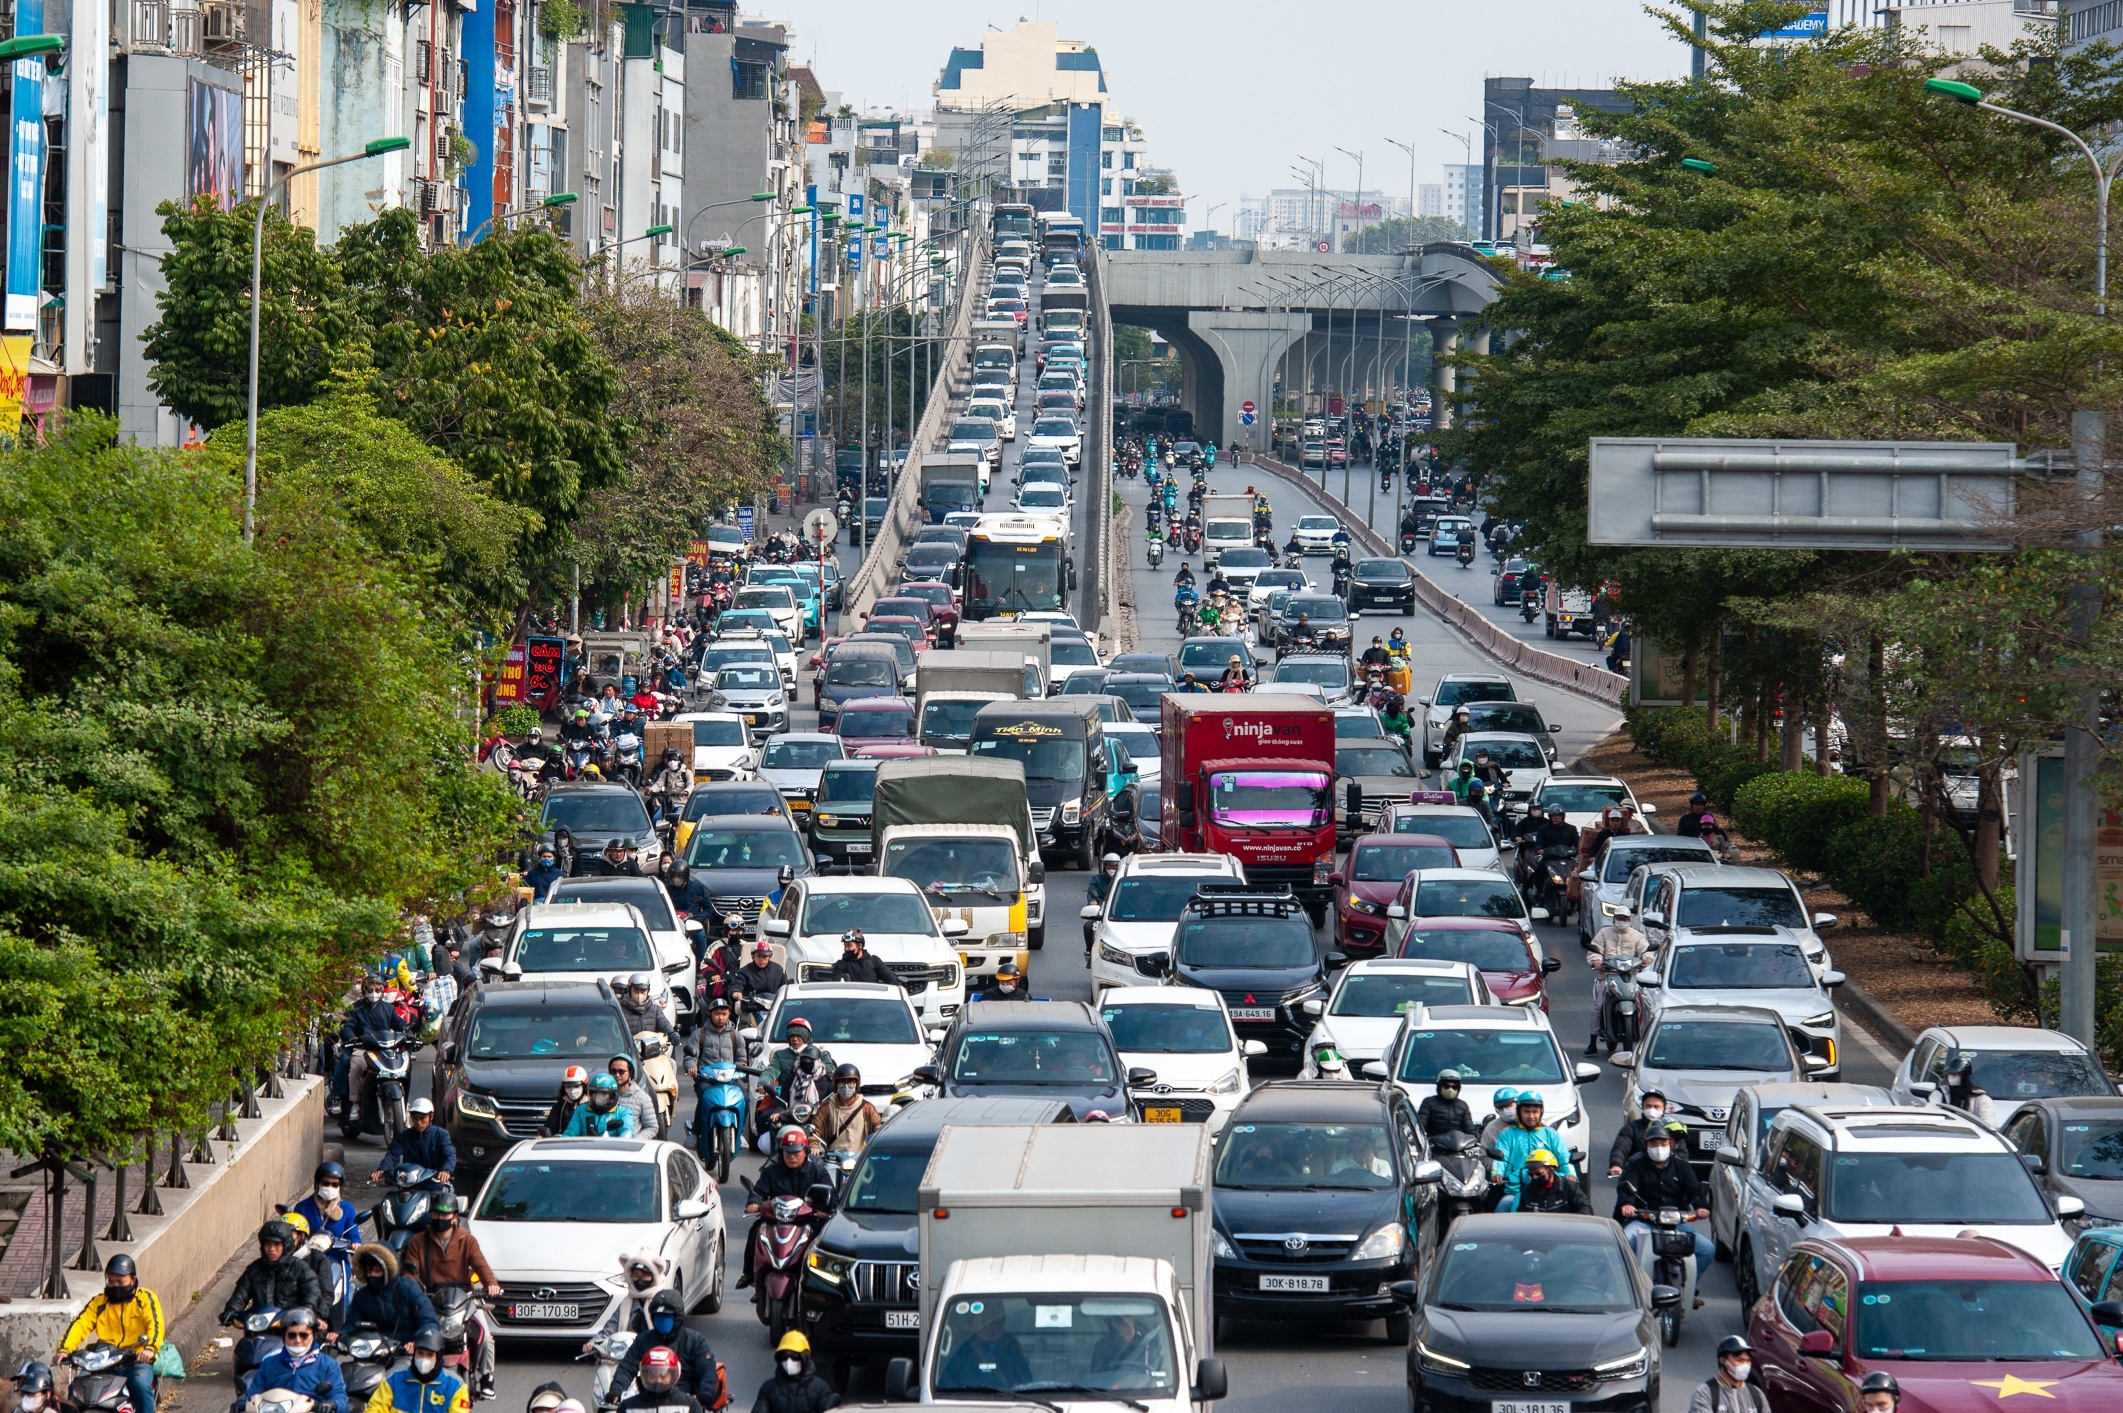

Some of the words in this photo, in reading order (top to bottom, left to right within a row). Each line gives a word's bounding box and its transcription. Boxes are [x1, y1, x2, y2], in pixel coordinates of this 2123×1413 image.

[1239, 412, 1258, 420] P0
[1234, 721, 1301, 739] ninjavan
[1243, 844, 1301, 853] www.ninjavan.co
[1155, 1109, 1171, 1118] 30G
[1710, 1132, 1724, 1140] 30
[1265, 1278, 1323, 1290] 30K-818.78
[517, 1305, 577, 1317] 30F-170.98
[430, 1390, 445, 1406] be
[1499, 1404, 1564, 1413] 30L-181.36
